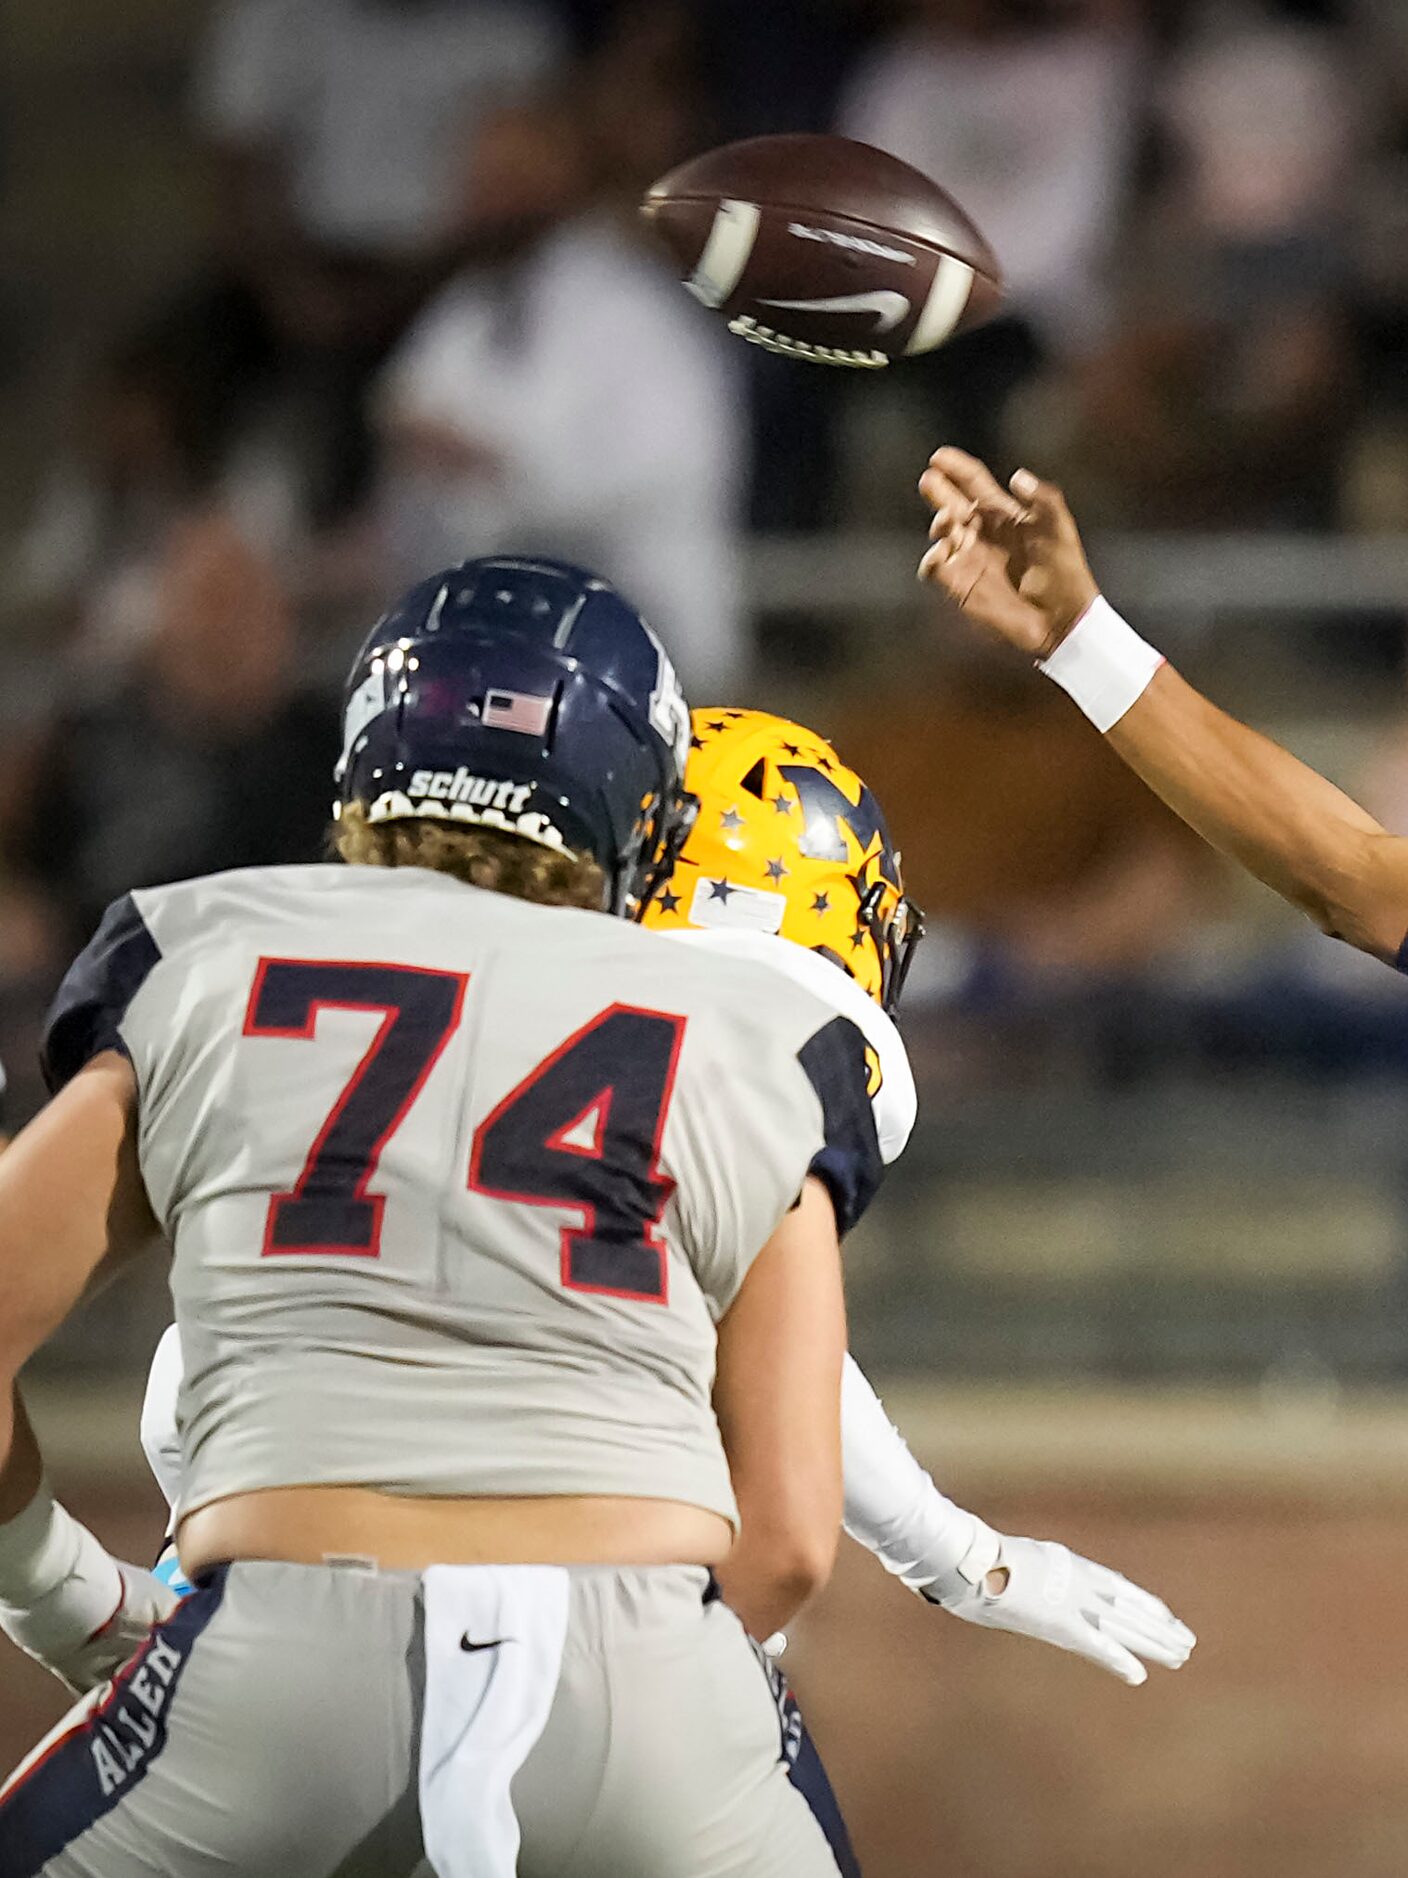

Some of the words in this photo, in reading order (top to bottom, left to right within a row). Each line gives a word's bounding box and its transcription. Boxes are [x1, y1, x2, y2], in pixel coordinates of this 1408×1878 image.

[407, 765, 532, 813] schutt
[242, 955, 688, 1306] 74
[91, 1633, 181, 1796] ALLEN
